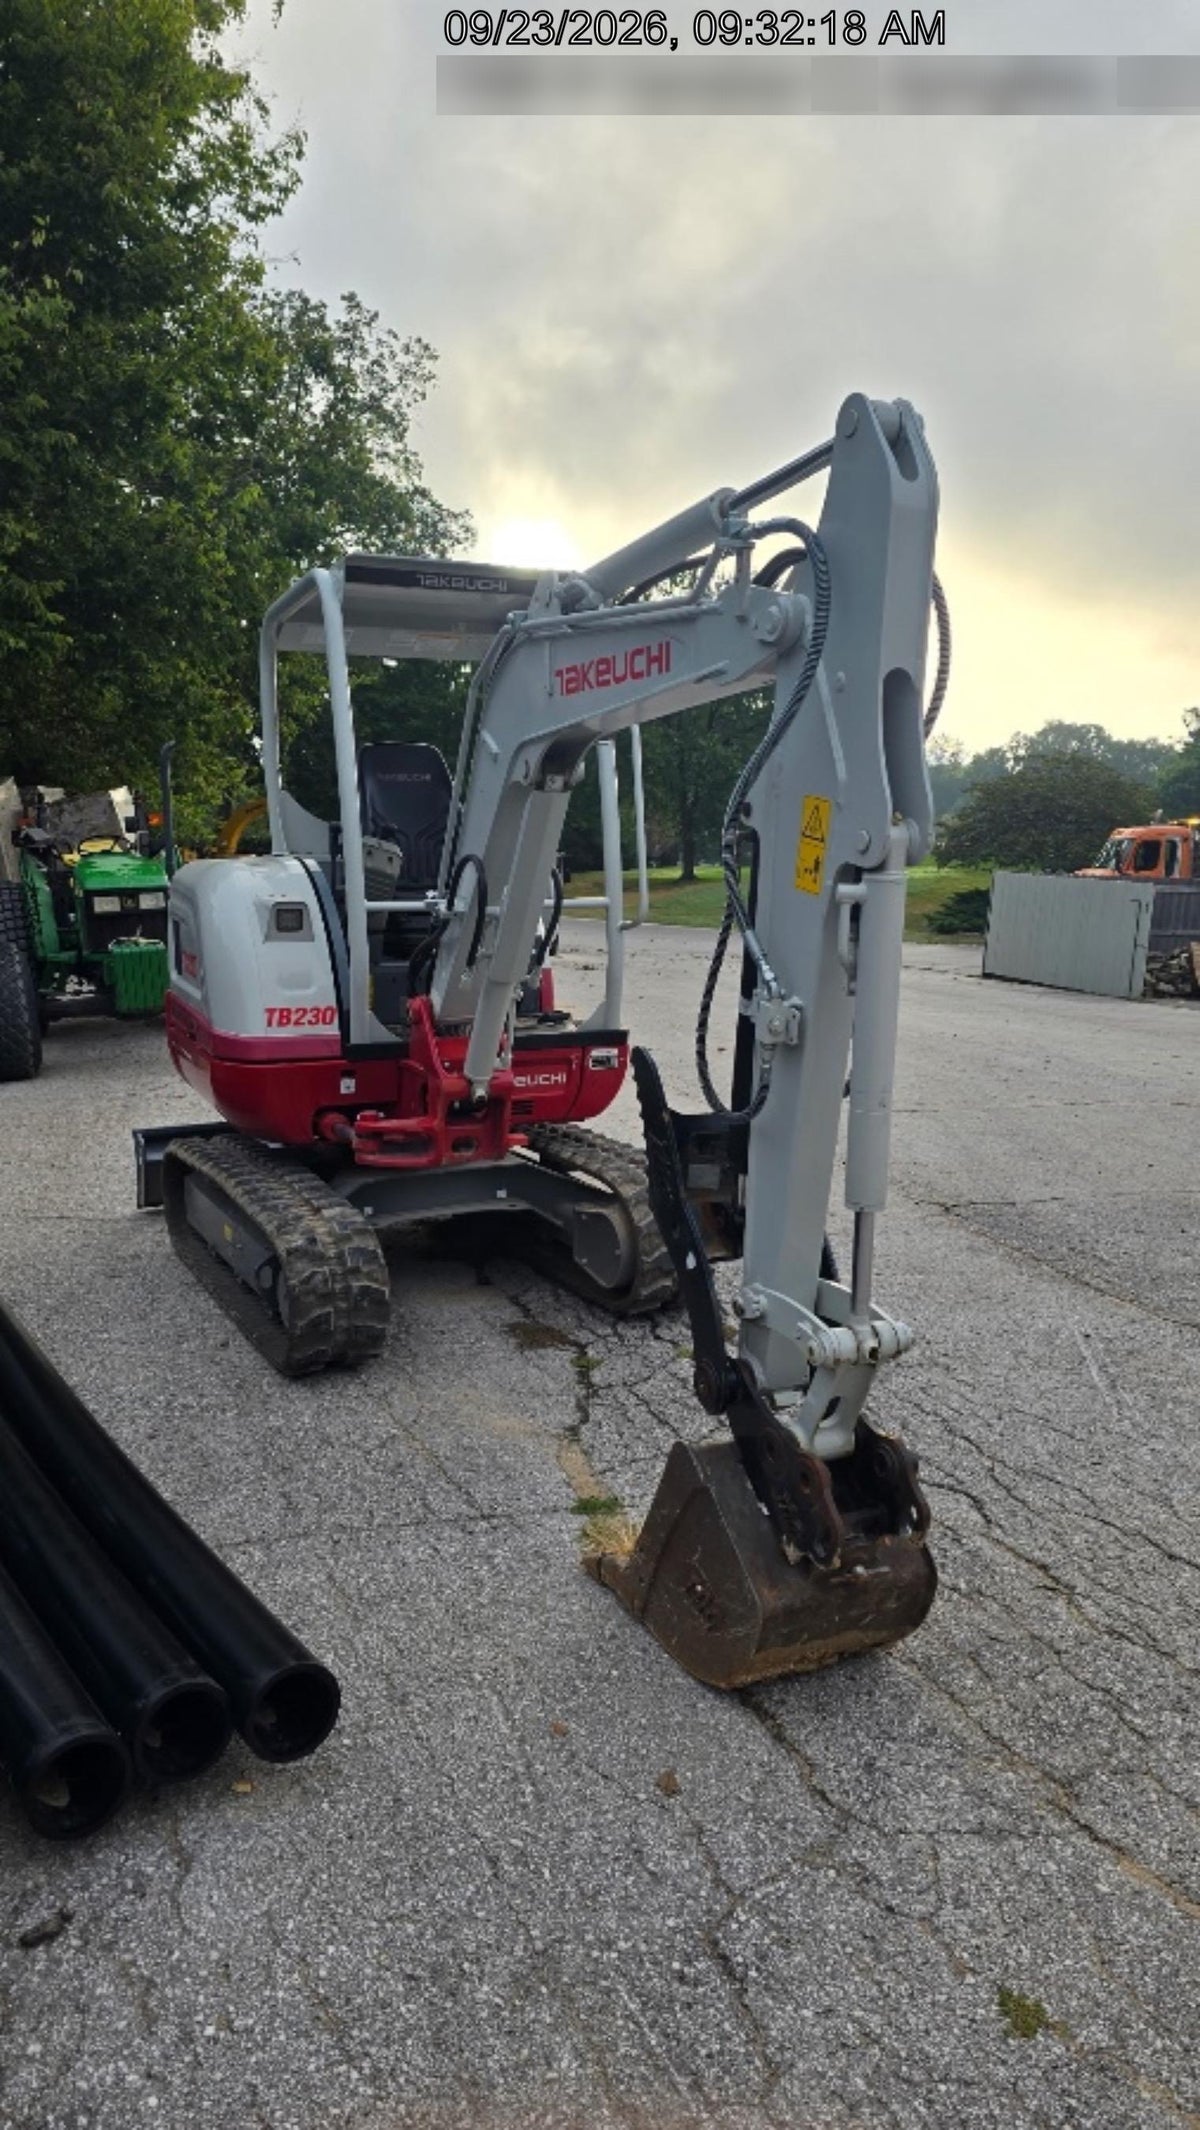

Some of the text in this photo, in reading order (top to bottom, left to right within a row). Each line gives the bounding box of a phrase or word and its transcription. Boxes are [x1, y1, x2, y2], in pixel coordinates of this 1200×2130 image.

[416, 574, 508, 593] TAKEUCHI
[555, 640, 671, 697] TAKEUCHI
[264, 1005, 337, 1028] TB230
[513, 1072, 567, 1087] EUCHI
